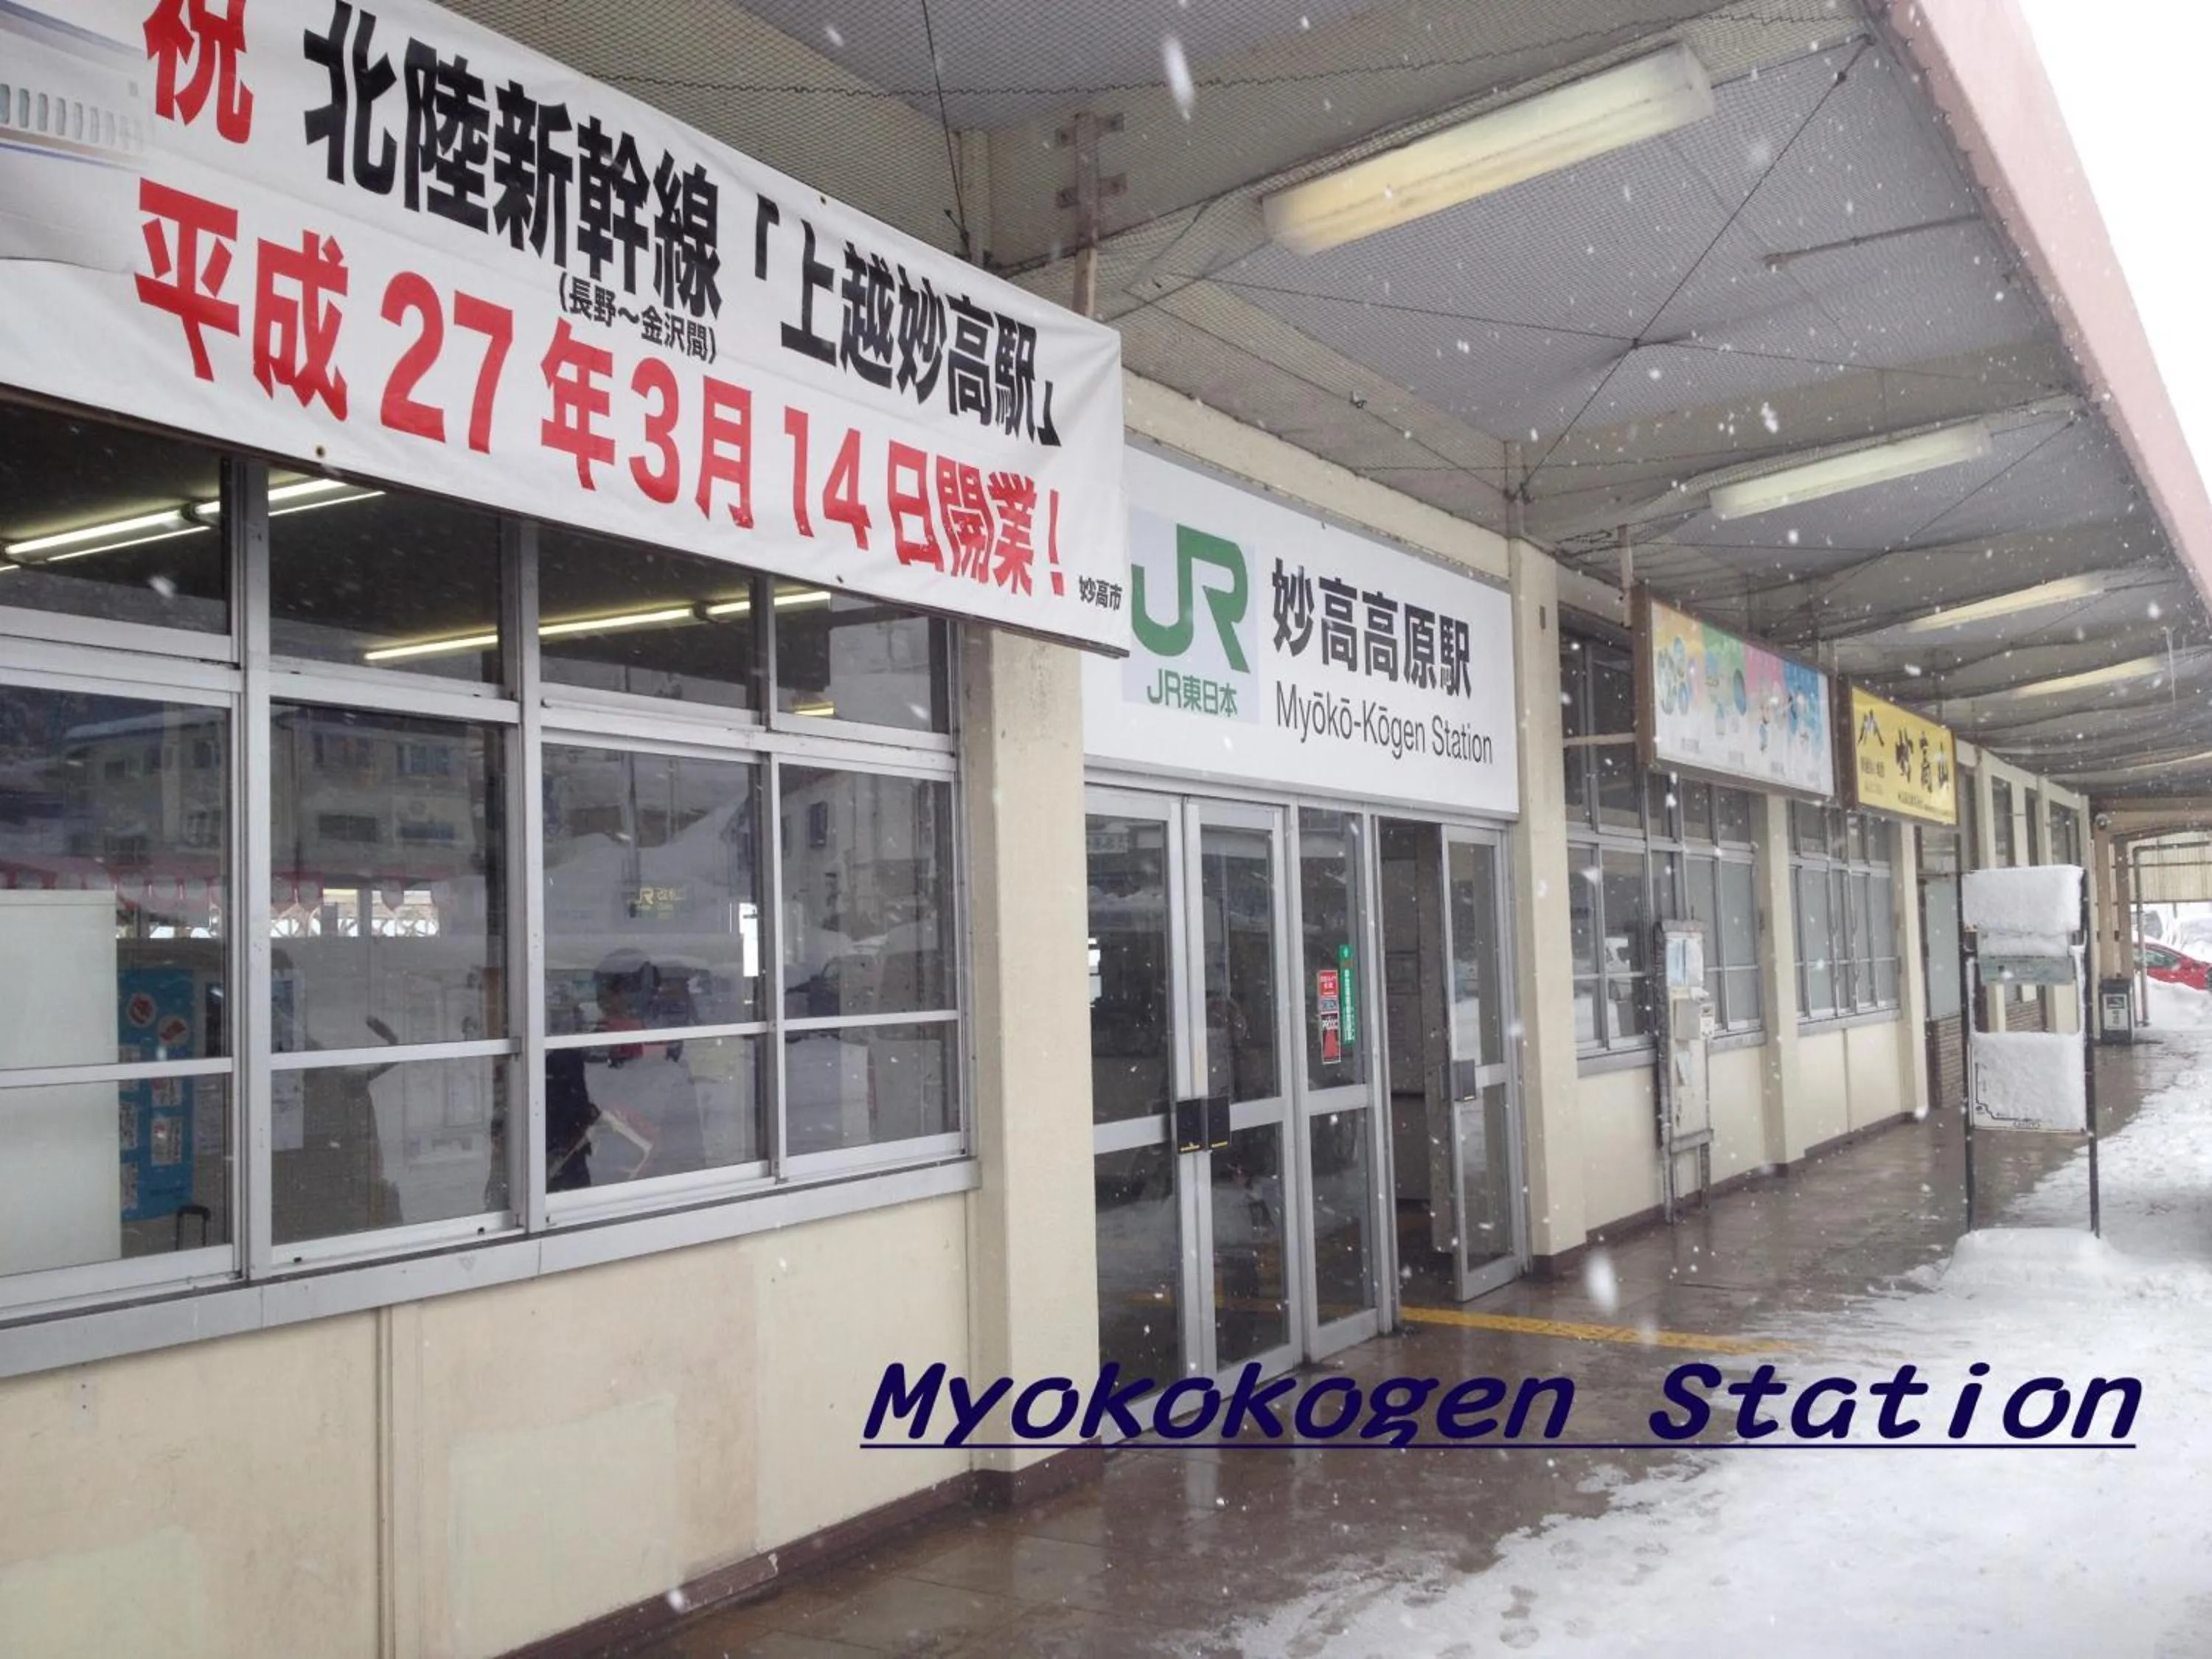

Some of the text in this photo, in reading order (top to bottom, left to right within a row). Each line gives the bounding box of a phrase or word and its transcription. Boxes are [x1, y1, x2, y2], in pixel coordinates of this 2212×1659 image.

[142, 0, 254, 145] 祝
[1079, 575, 1123, 611] 妙高市
[1131, 524, 1251, 674] JR
[1272, 558, 1472, 698] 妙高高原駅
[1147, 669, 1237, 717] JR東日本
[1276, 681, 1493, 764] Myōkō-Kōgen Station
